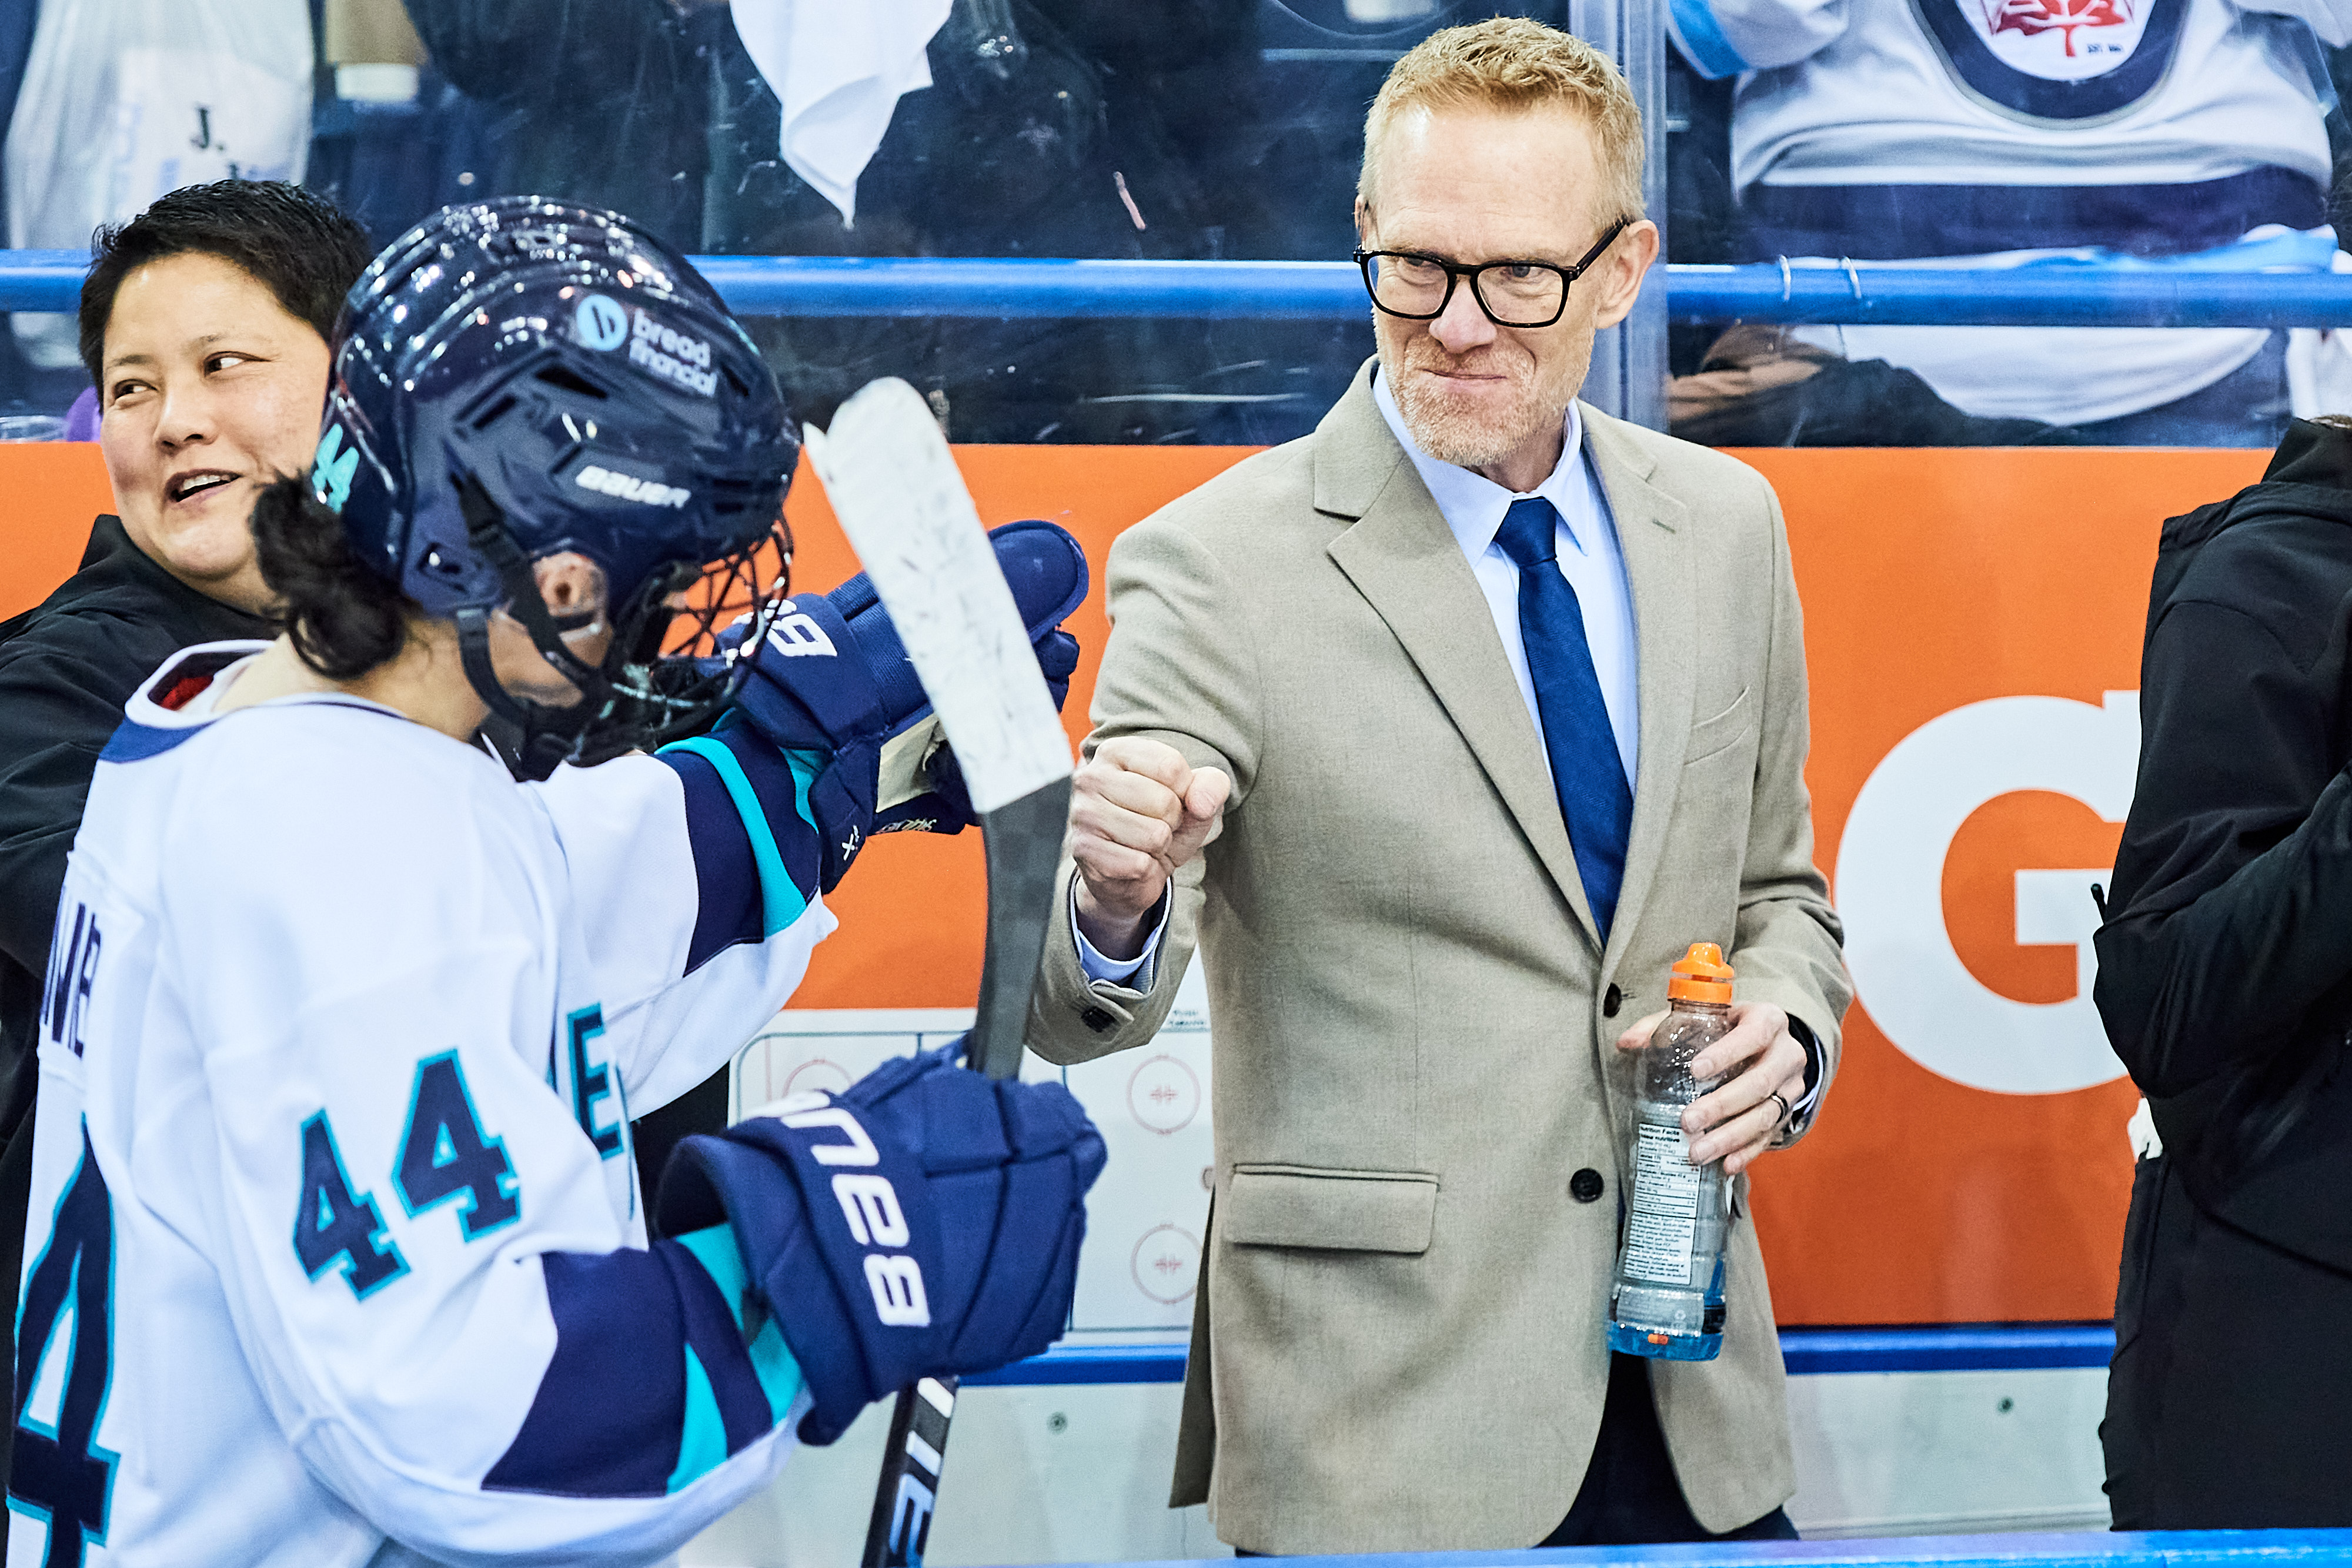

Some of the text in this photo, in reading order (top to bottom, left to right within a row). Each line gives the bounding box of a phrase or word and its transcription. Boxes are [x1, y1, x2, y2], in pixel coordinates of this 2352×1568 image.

[629, 337, 717, 397] financial
[633, 307, 710, 368] bread
[293, 1048, 520, 1303] 44
